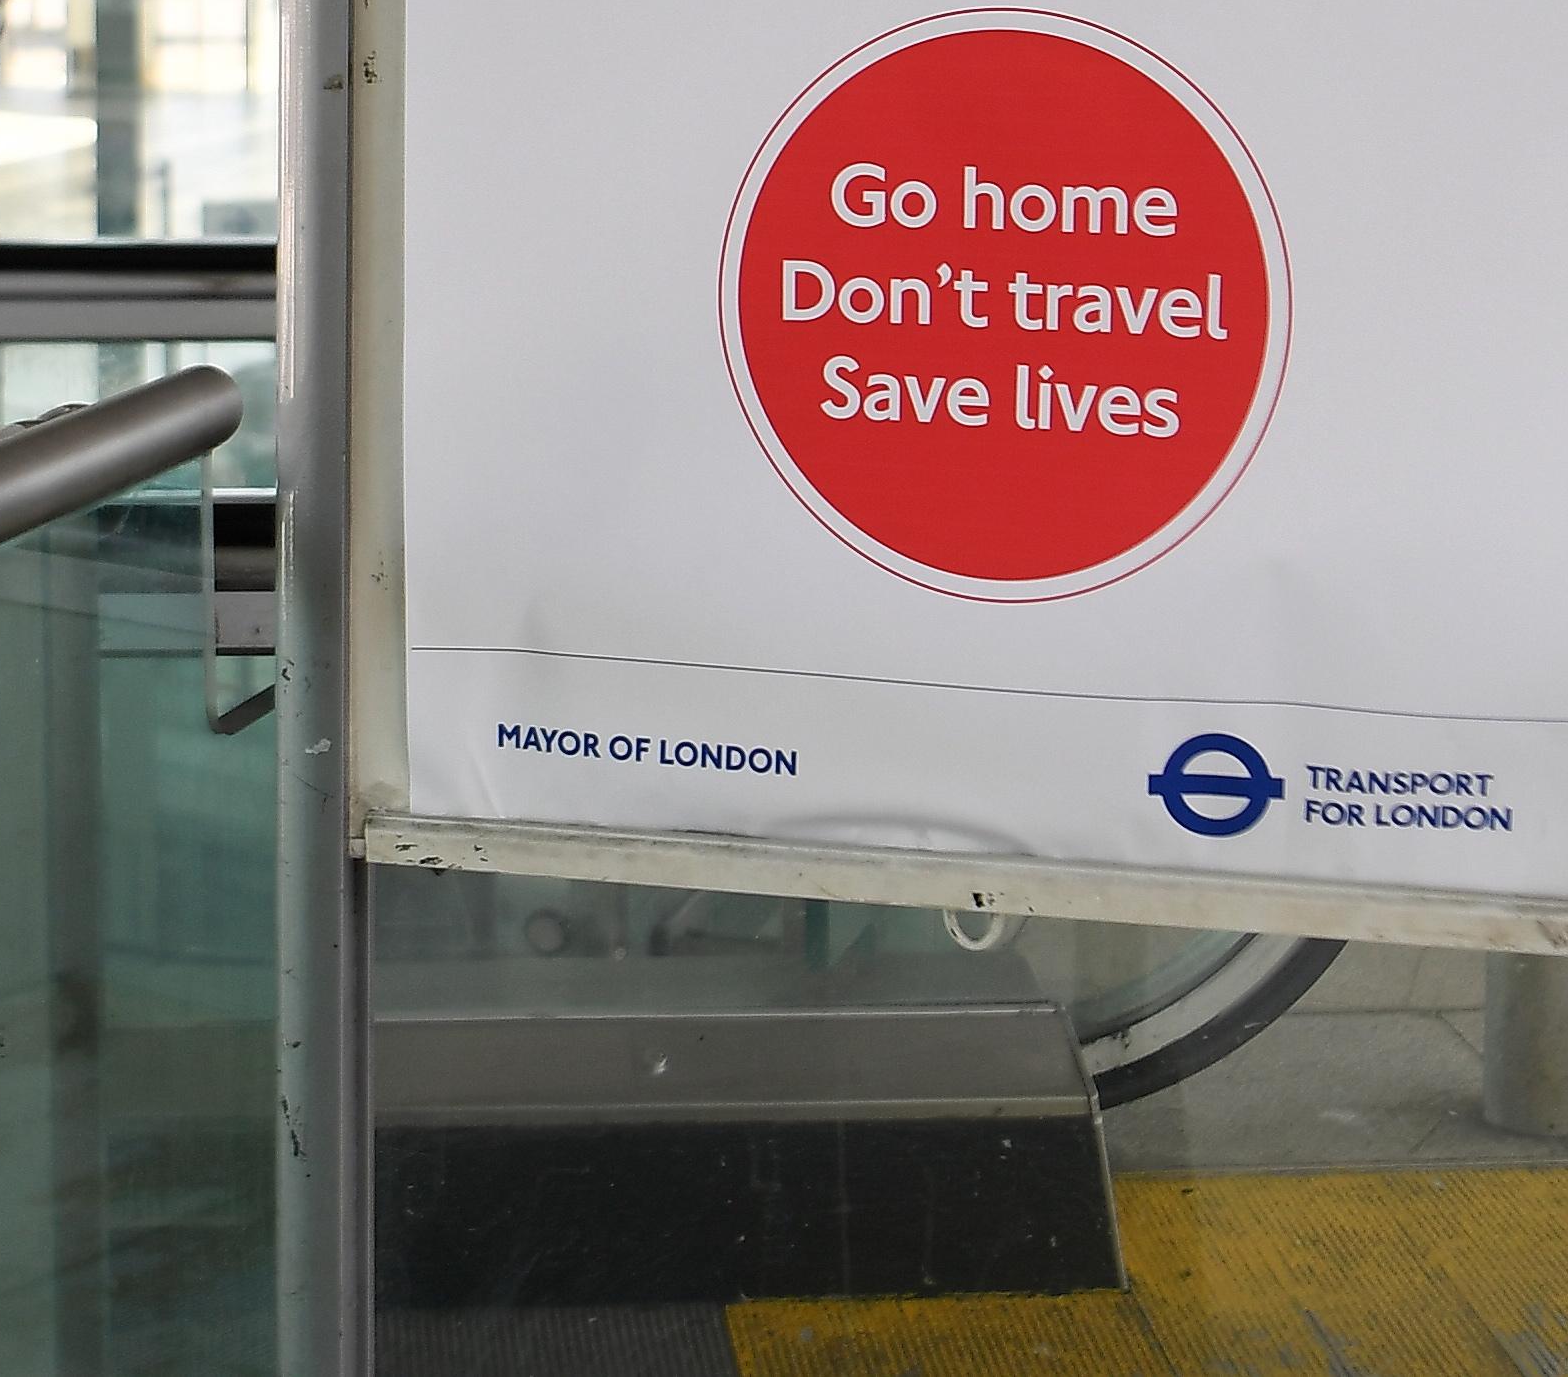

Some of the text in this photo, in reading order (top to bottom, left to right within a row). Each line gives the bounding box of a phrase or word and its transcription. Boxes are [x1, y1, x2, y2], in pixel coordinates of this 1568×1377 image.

[830, 162, 1179, 238] Go home
[781, 260, 1229, 341] Don’t travel
[819, 355, 1180, 439] Save lives
[497, 723, 798, 777] MAYOR OF LONDON
[1305, 764, 1495, 798] TRANSPORT
[1304, 799, 1514, 832] FOR LONDON
